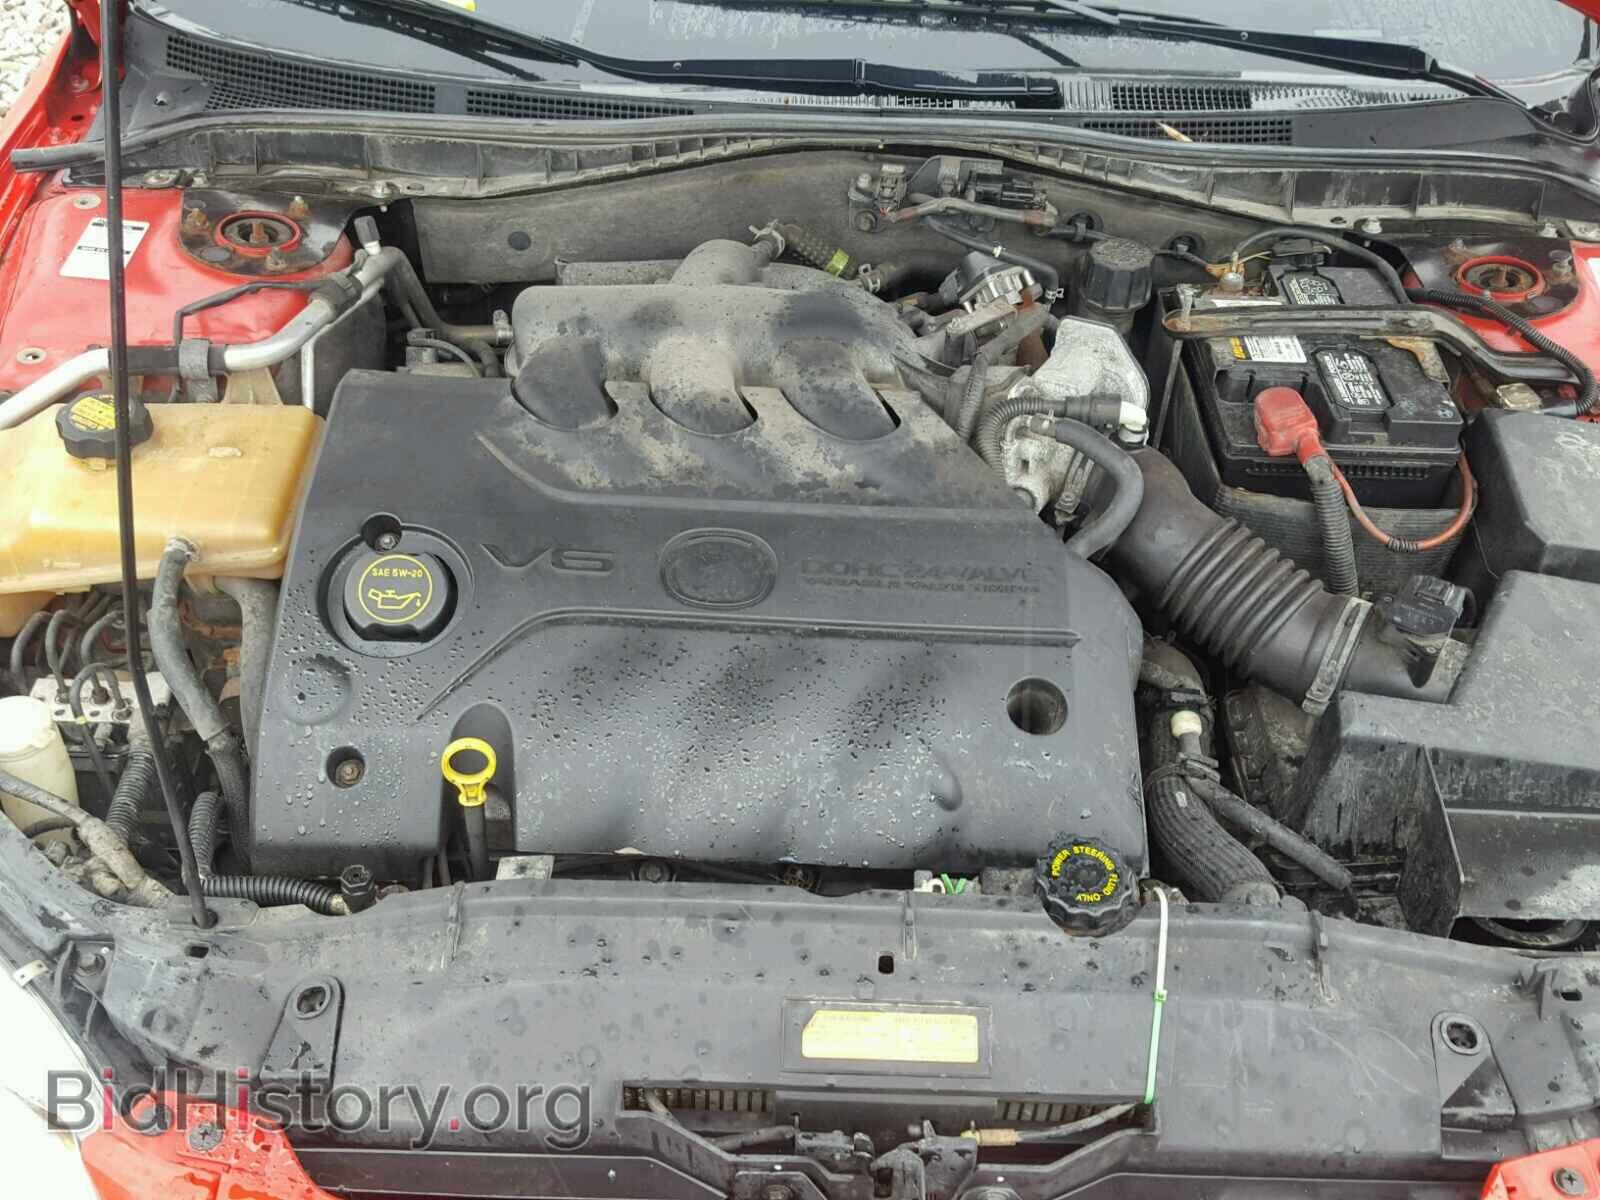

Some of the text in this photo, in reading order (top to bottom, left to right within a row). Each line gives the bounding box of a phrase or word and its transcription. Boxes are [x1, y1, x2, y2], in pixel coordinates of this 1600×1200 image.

[371, 567, 424, 578] SAE 5W-20
[480, 543, 615, 576] V6
[1051, 845, 1120, 903] POWER STEERING FLUID ONLY
